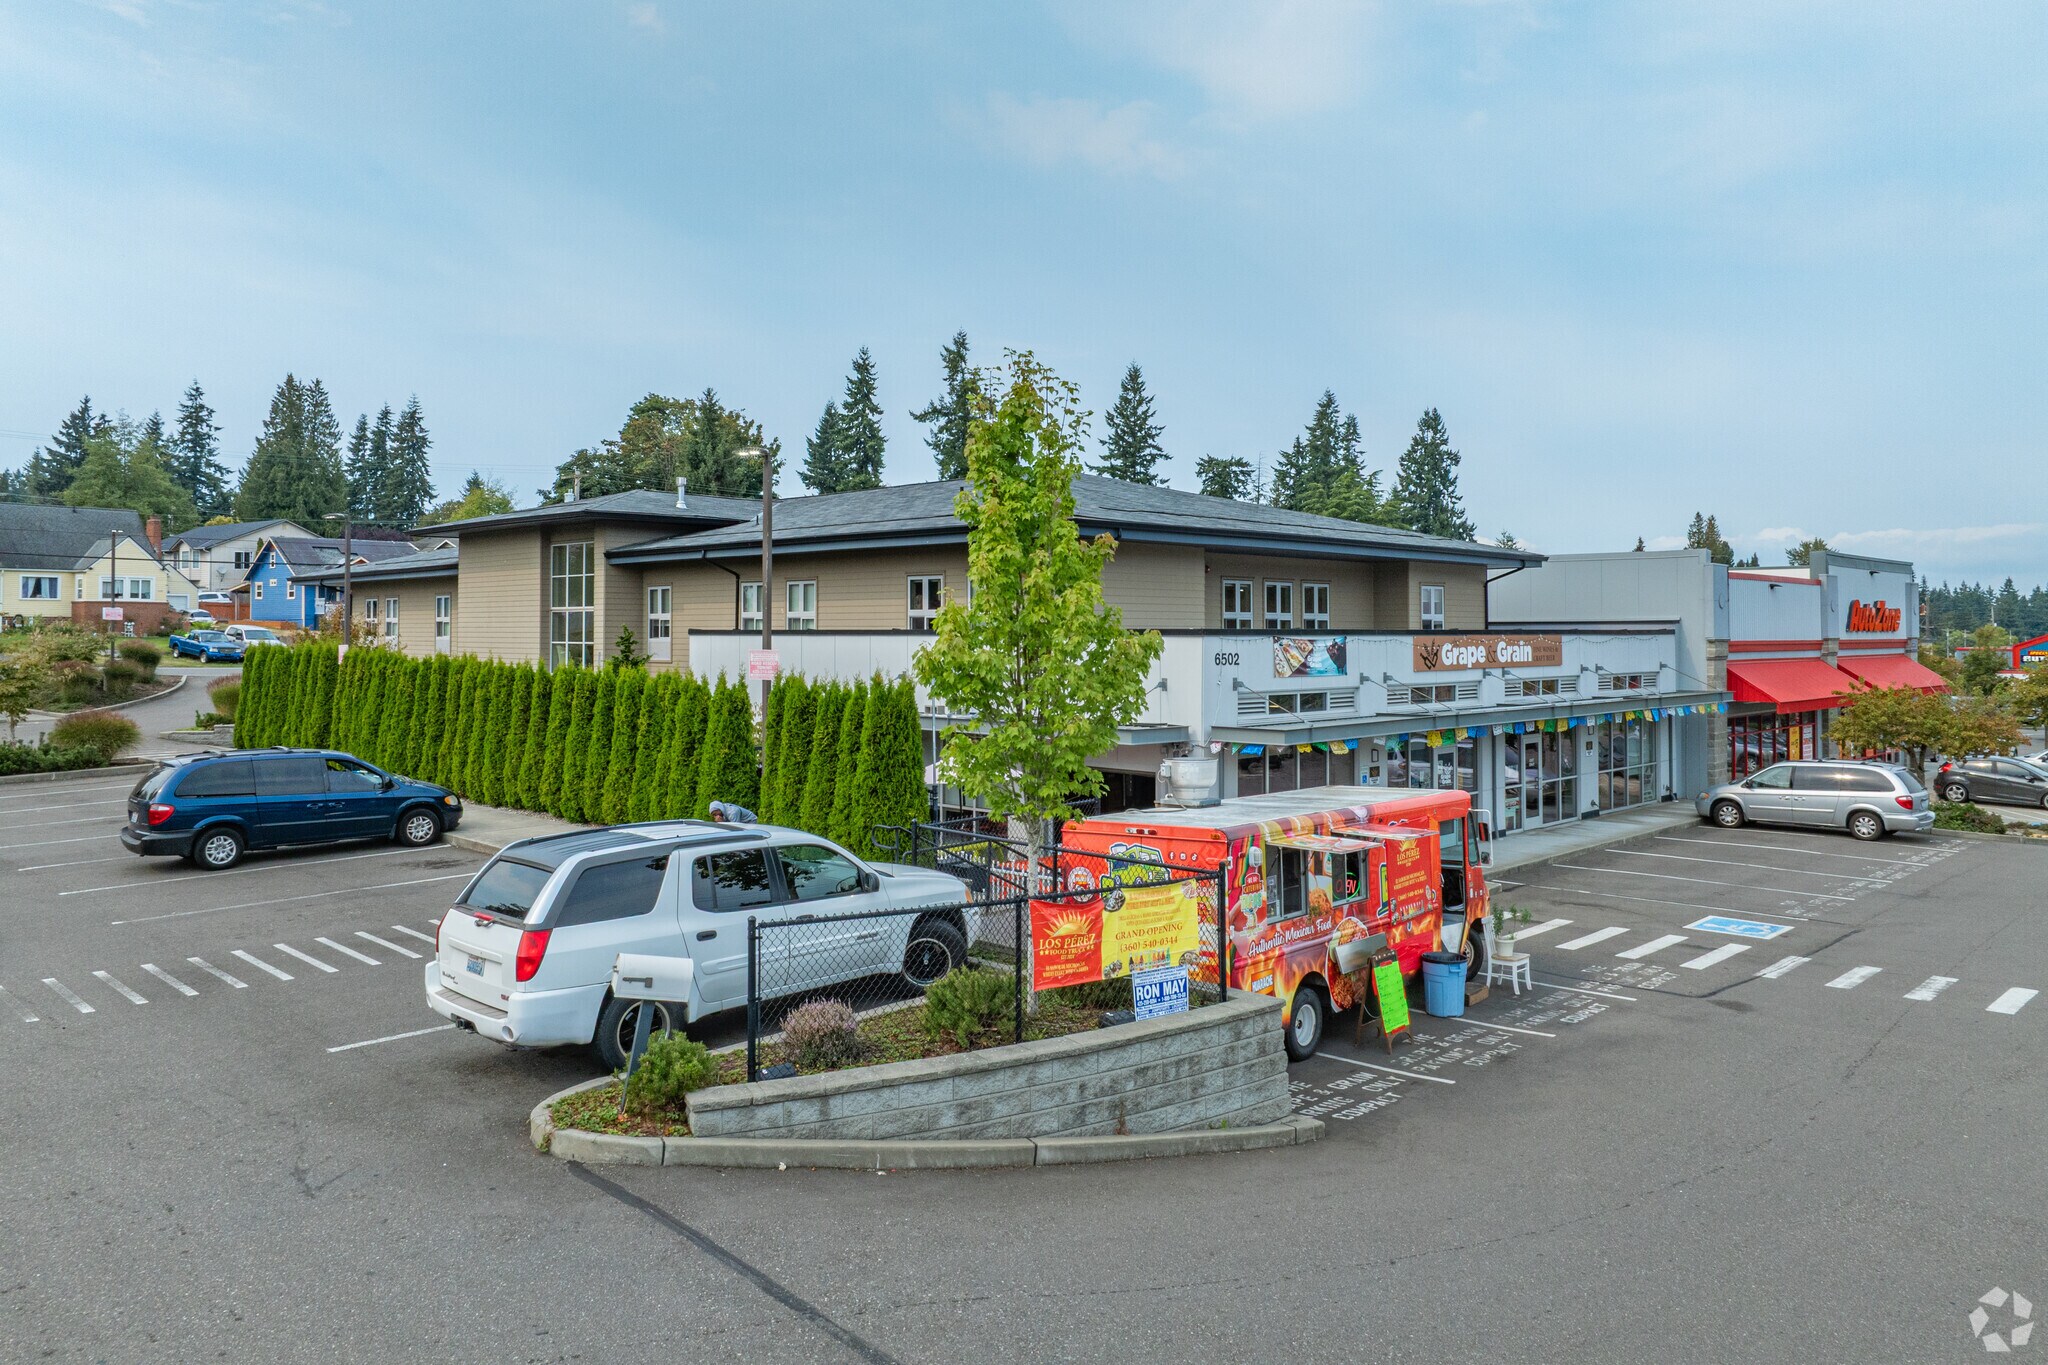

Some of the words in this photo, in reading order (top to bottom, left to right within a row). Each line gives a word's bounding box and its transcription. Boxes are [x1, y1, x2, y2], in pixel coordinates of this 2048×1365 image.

[1847, 600, 1901, 632] AutoZone
[1214, 652, 1240, 666] 6502
[1441, 642, 1486, 668] Grape
[1487, 645, 1497, 663] &
[1497, 641, 1533, 663] Grain
[1335, 879, 1357, 893] OEN
[1115, 928, 1145, 941] GRAND
[1147, 922, 1183, 935] OPENING
[1248, 932, 1285, 957] Authentic
[1286, 925, 1314, 943] Mexican
[1316, 916, 1332, 932] Food
[1040, 938, 1061, 950] LOS
[1064, 934, 1095, 949] PÉREZ
[1120, 941, 1141, 953] (360)
[1143, 936, 1178, 949] 540-0344
[1136, 983, 1160, 1001] RON
[1163, 979, 1185, 996] MAY
[1288, 1081, 1312, 1094] HE
[1327, 1072, 1377, 1090] GRAIN
[1299, 1097, 1354, 1116] RKING
[1362, 1076, 1406, 1091] ONLY
[1332, 1092, 1402, 1120] COMPACT
